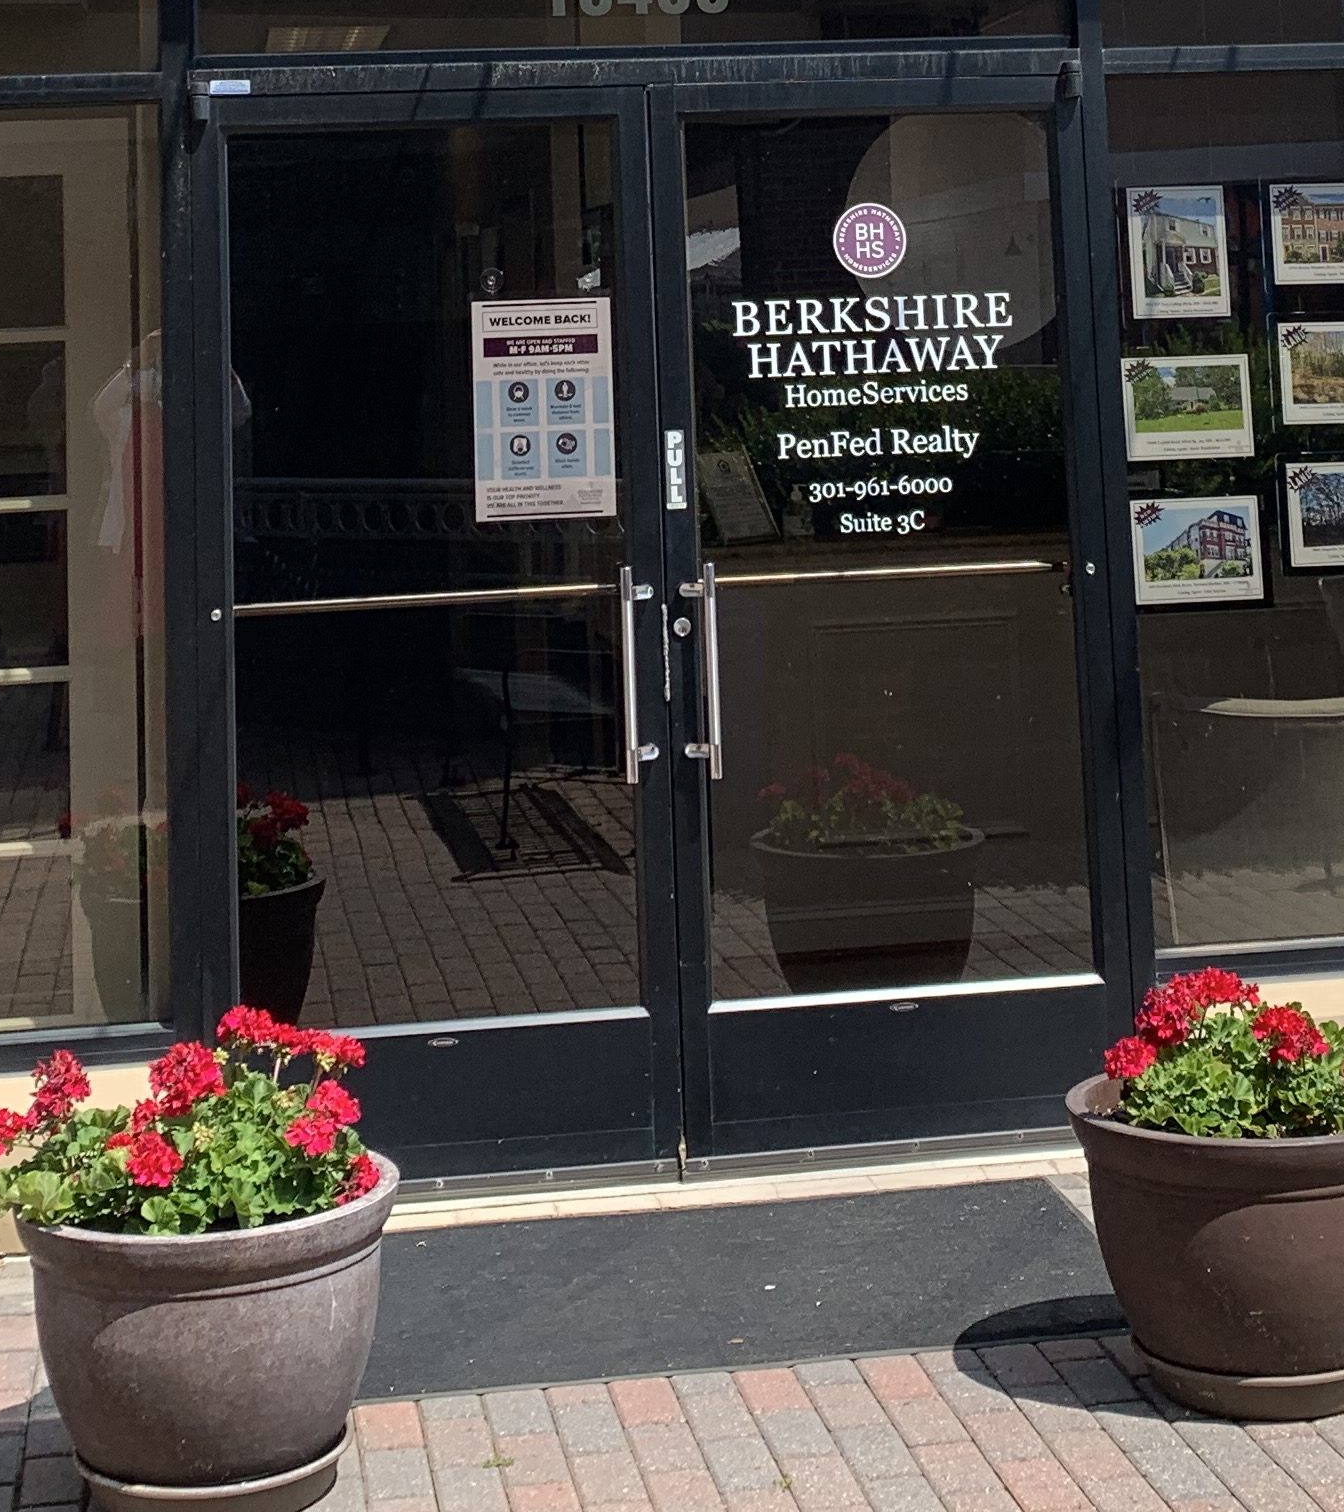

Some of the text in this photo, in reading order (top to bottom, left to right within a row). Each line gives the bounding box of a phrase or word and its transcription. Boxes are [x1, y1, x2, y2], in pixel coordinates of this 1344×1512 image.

[855, 222, 885, 241] BH
[855, 240, 885, 259] HS
[489, 314, 591, 327] WELCOME BACK!
[731, 292, 1013, 337] BERKSHIRE
[747, 334, 1004, 379] HATHAWAY
[783, 379, 969, 408] HomeServices
[776, 425, 980, 460] PenFed Realty
[666, 431, 684, 503] PULL
[808, 475, 953, 503] 301-961-6000
[840, 509, 926, 535] Suite 3C
